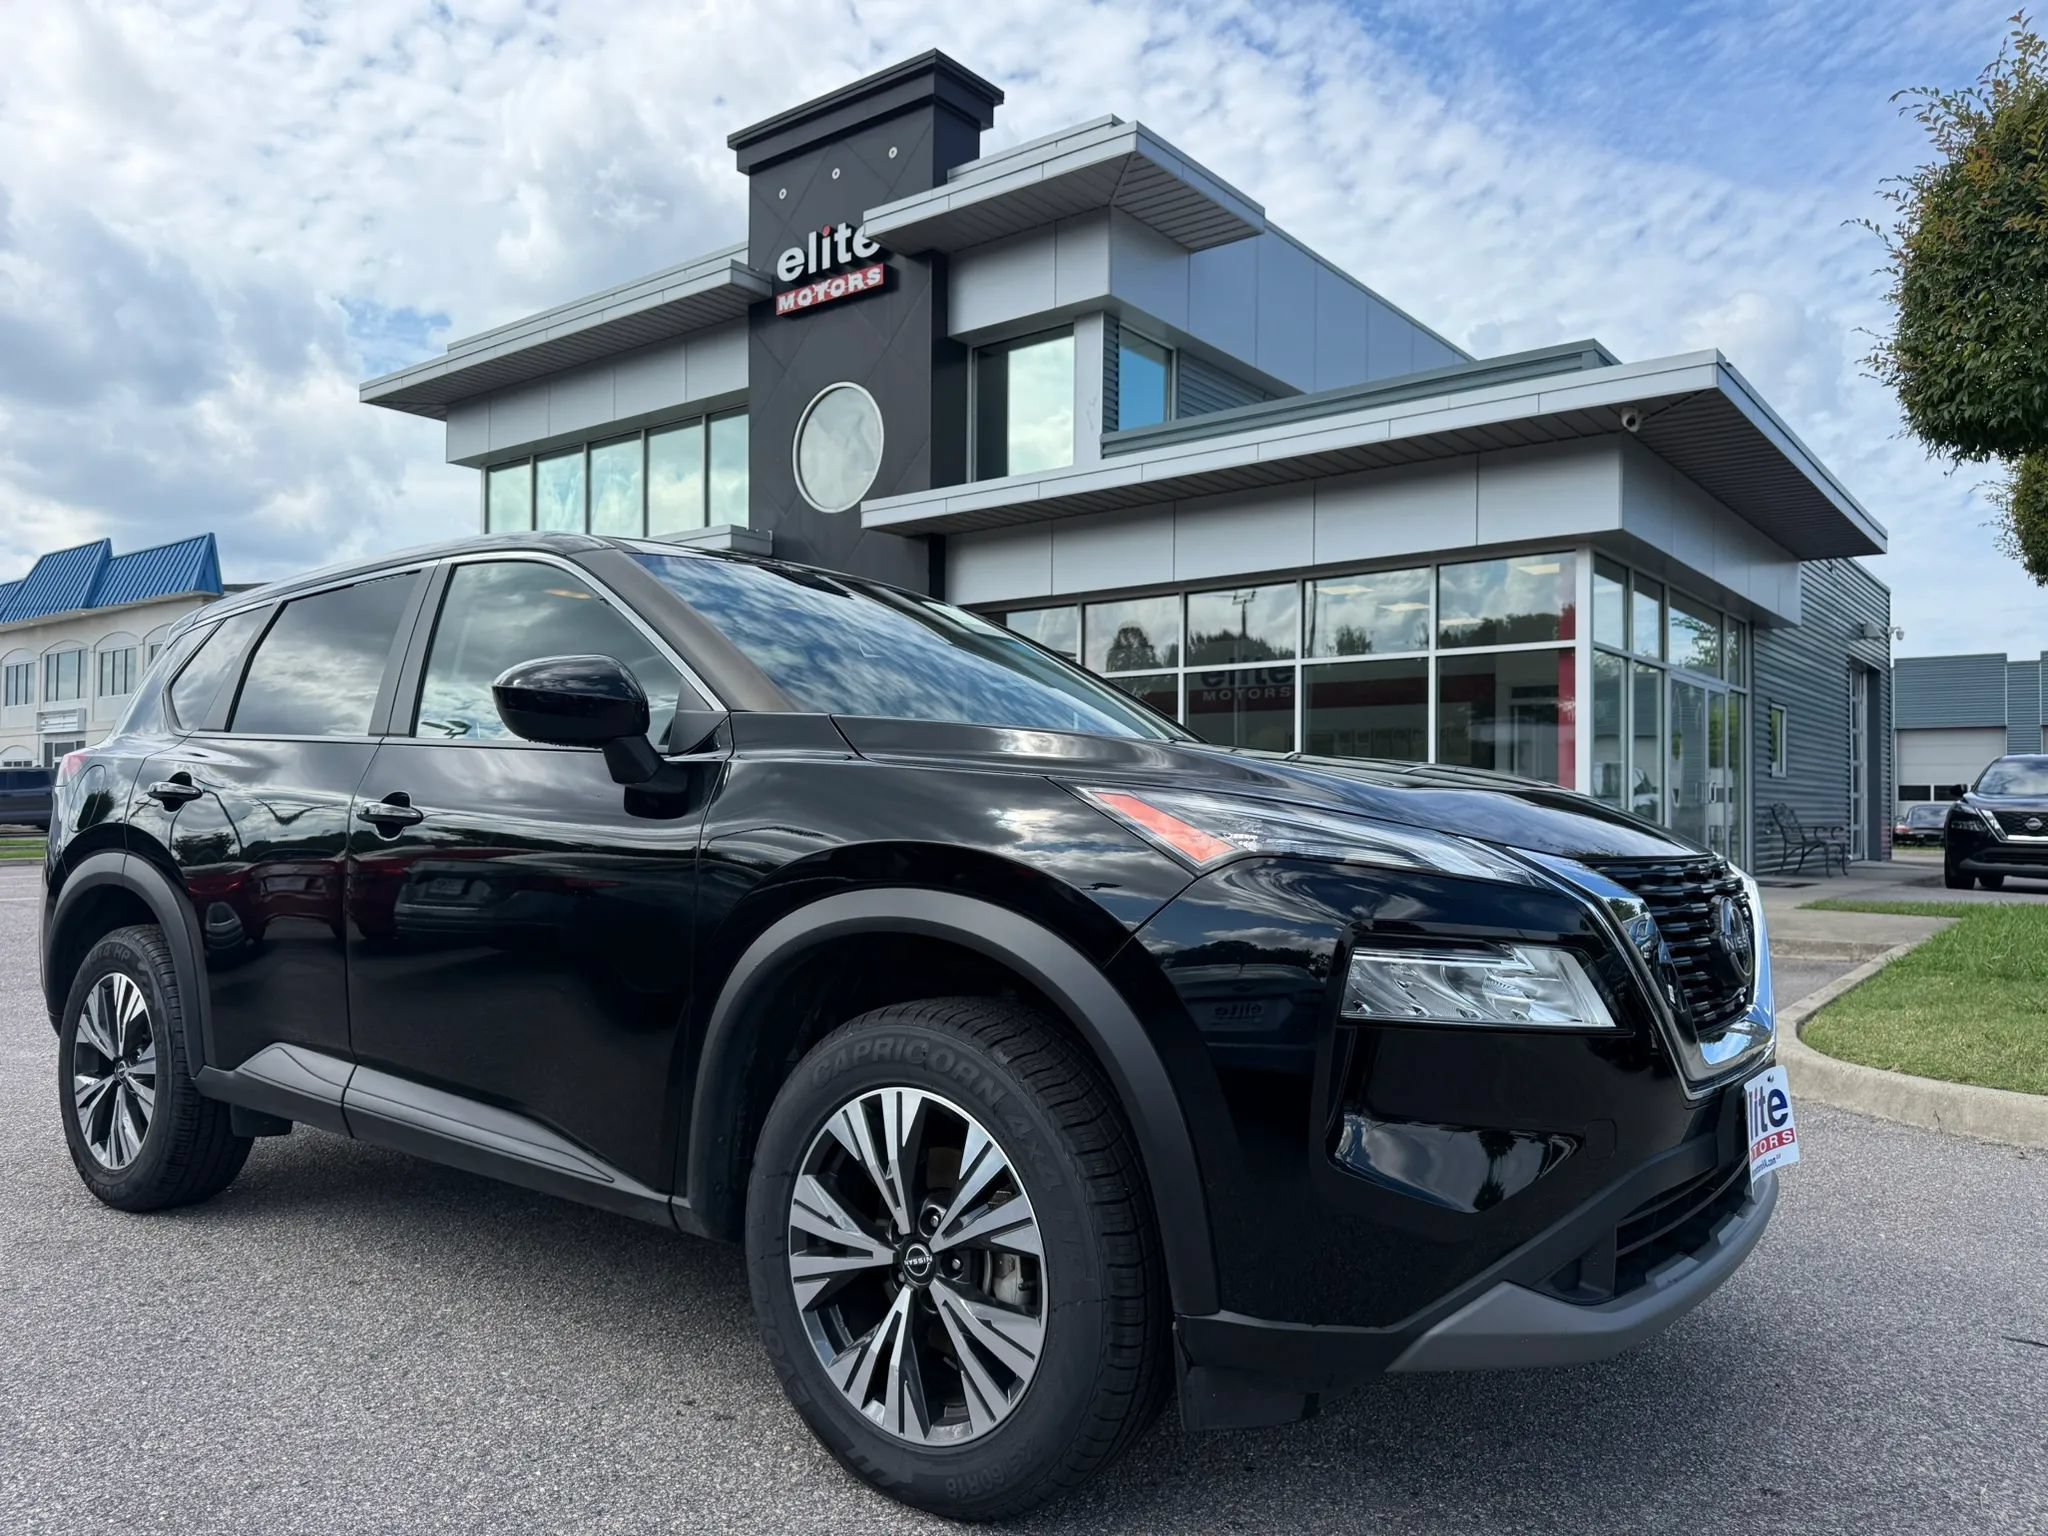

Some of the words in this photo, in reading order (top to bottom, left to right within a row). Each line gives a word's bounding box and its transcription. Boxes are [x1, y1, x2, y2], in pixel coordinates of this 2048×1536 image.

[777, 222, 881, 282] elite
[778, 267, 881, 311] MOTORS
[1202, 686, 1293, 701] MOTORS
[813, 1036, 1009, 1107] CAPRICORN
[1749, 1086, 1789, 1141] lite
[1752, 1130, 1793, 1159] TORS
